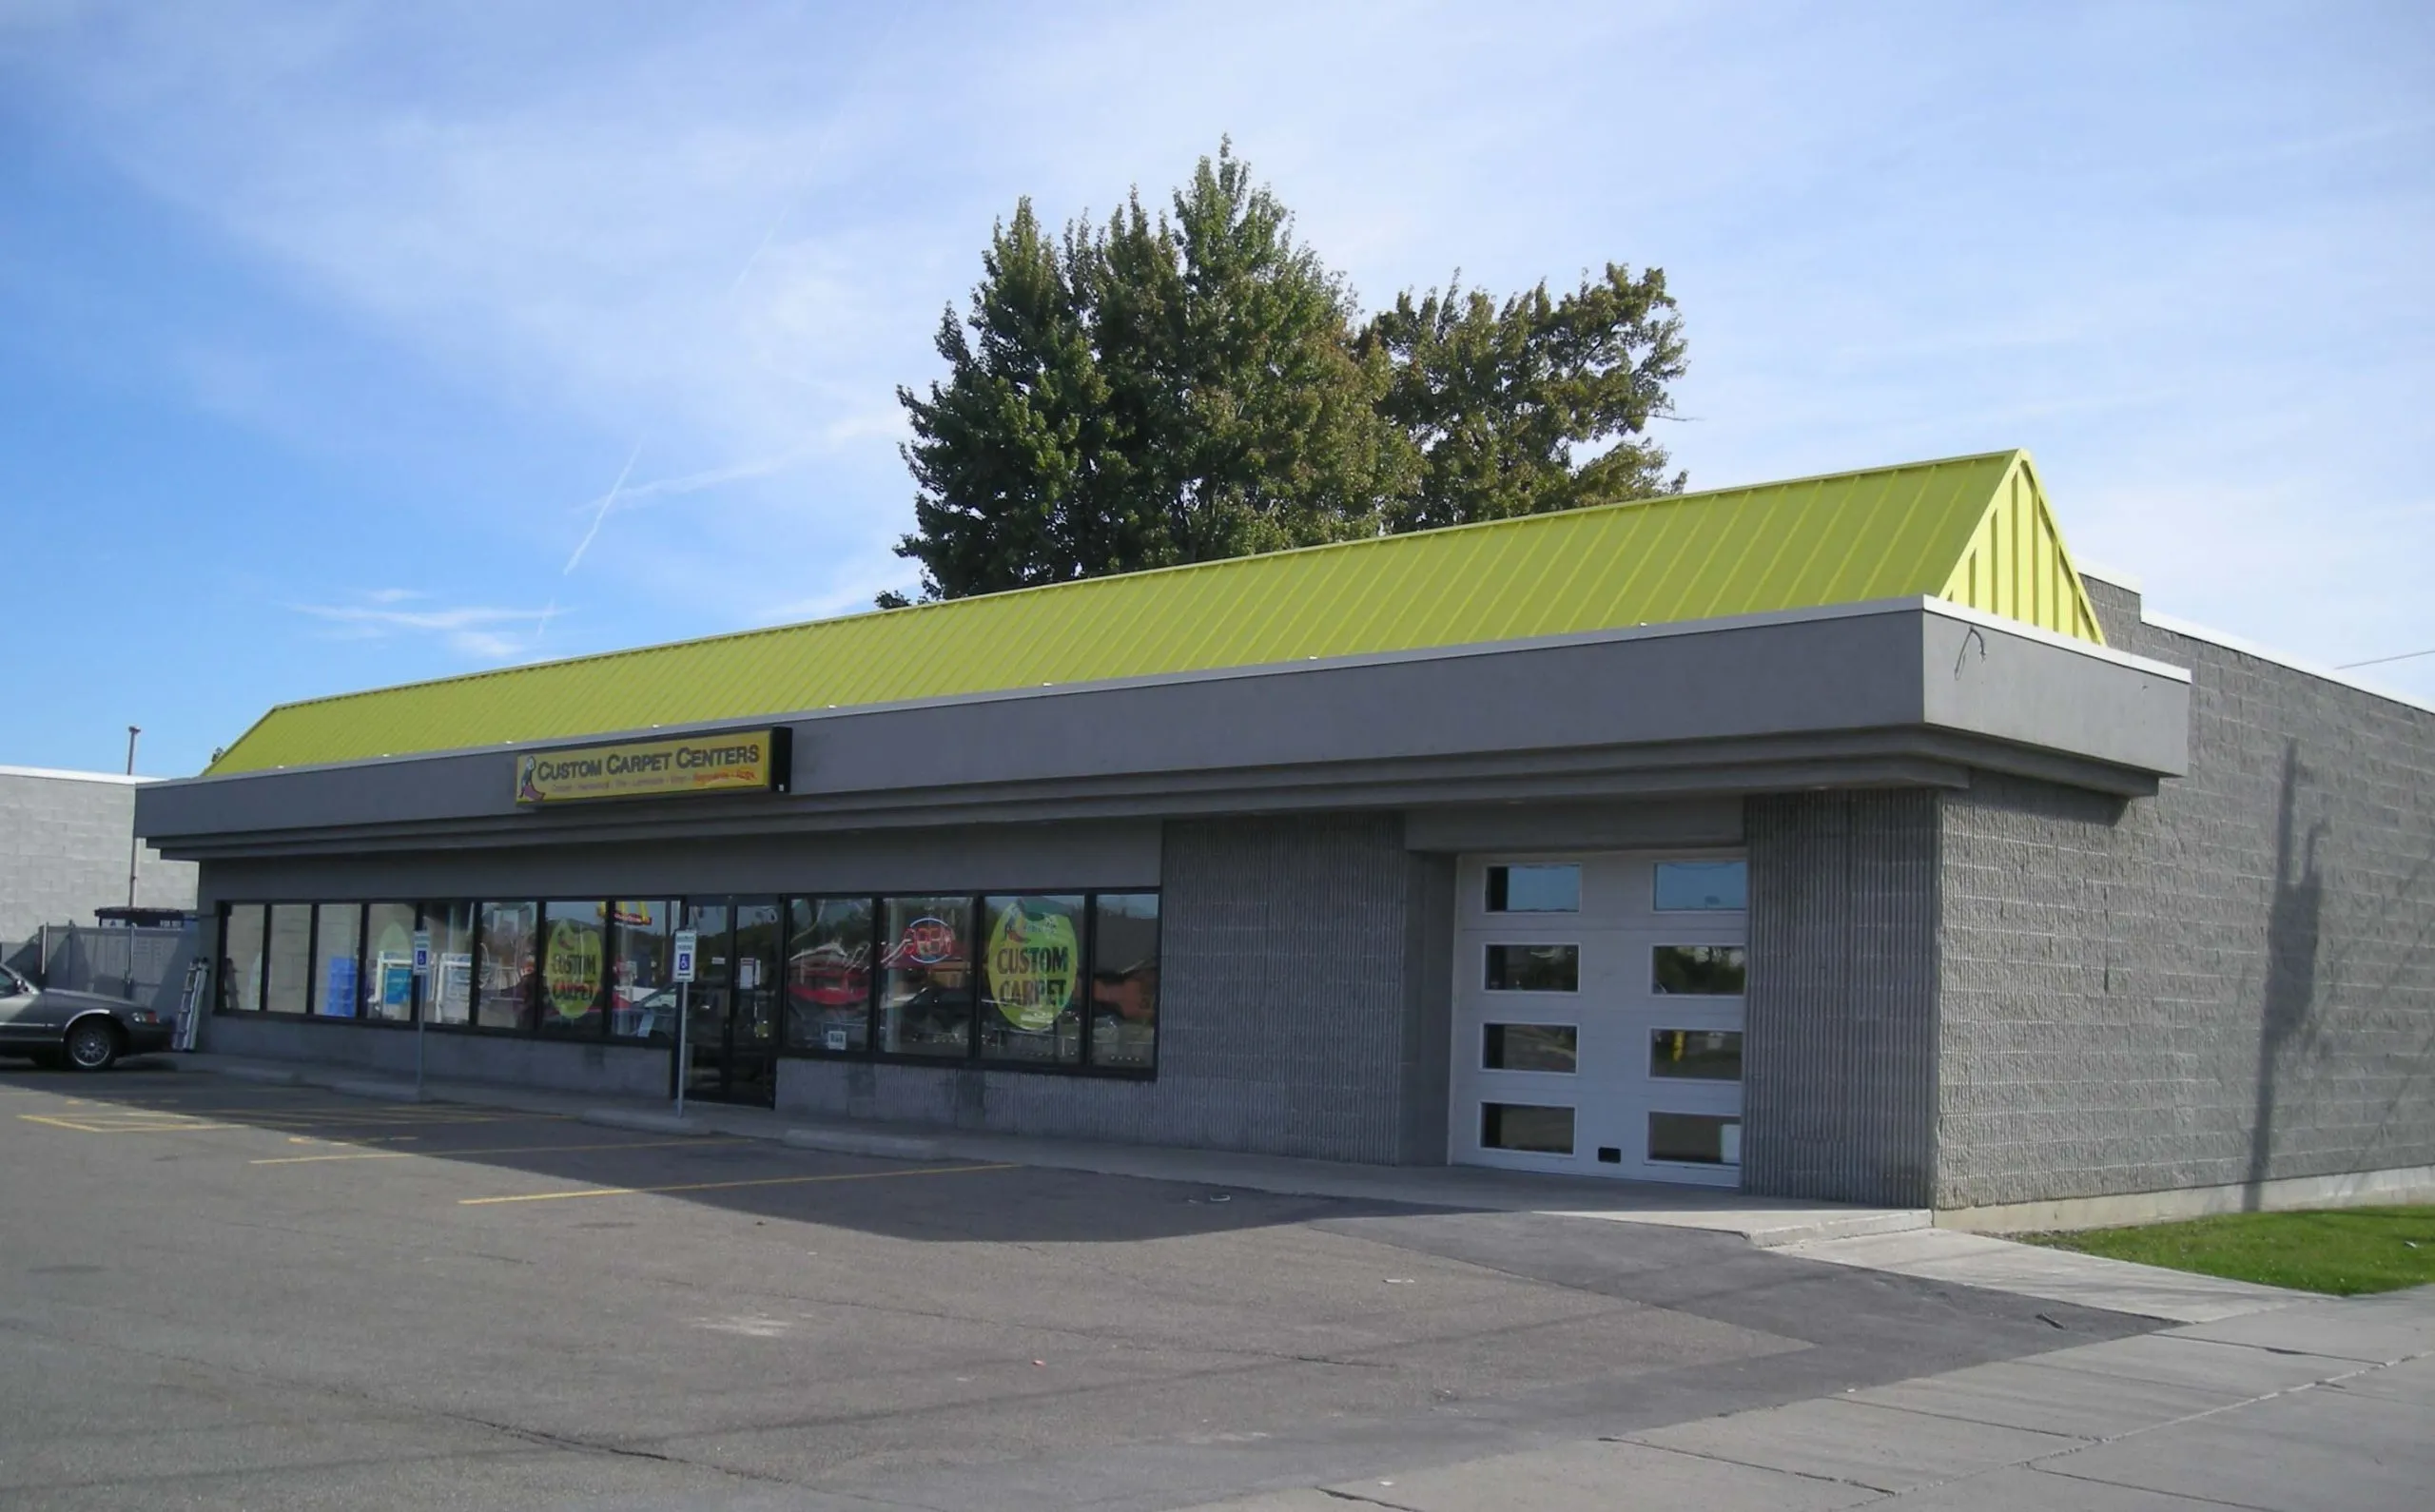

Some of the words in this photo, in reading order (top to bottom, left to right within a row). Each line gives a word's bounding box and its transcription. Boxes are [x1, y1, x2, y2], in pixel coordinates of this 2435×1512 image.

[538, 761, 601, 781] CUSTOM
[606, 753, 672, 774] CARPET
[676, 745, 760, 767] CENTERS
[996, 946, 1069, 975] CUSTOM
[999, 979, 1067, 1006] CARPET
